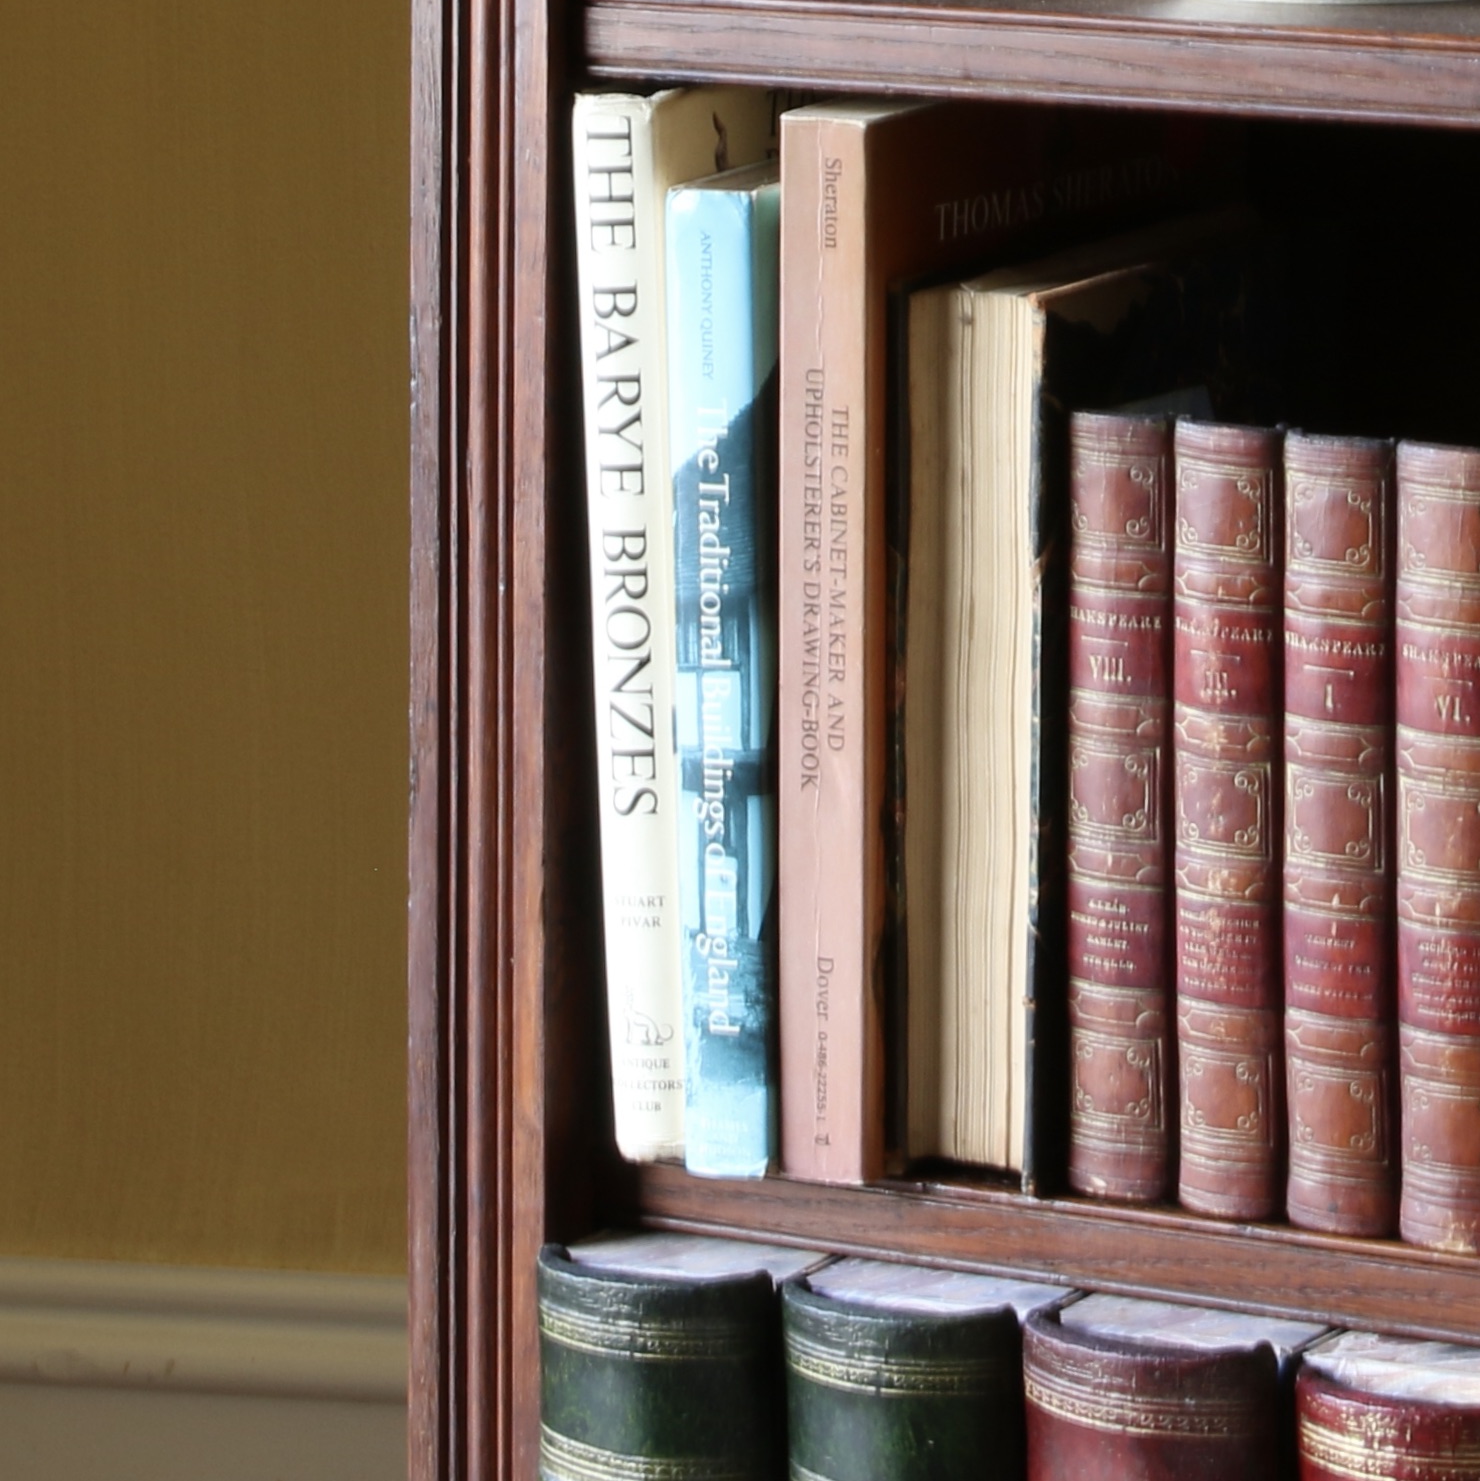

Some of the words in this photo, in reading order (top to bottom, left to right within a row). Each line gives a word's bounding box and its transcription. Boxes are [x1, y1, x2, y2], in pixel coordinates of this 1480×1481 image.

[587, 116, 636, 251] THE
[824, 158, 843, 249] Sheraton
[934, 181, 1044, 240] THOMAS
[698, 231, 712, 312] ANTHONY
[593, 280, 645, 498] BARYE
[701, 317, 715, 379] QUINEY
[696, 400, 728, 474] The
[800, 369, 825, 574] UPHOLSTERER'S
[831, 406, 848, 457] THE
[697, 473, 732, 669] Traditional
[828, 465, 848, 683] CABINET-MAKER
[603, 525, 659, 817] BRONZES
[800, 581, 822, 789] DRAWING-BOOK
[827, 695, 845, 752] AND
[694, 678, 734, 833] Buildings
[696, 888, 740, 1036] England
[815, 956, 834, 1021] Dover
